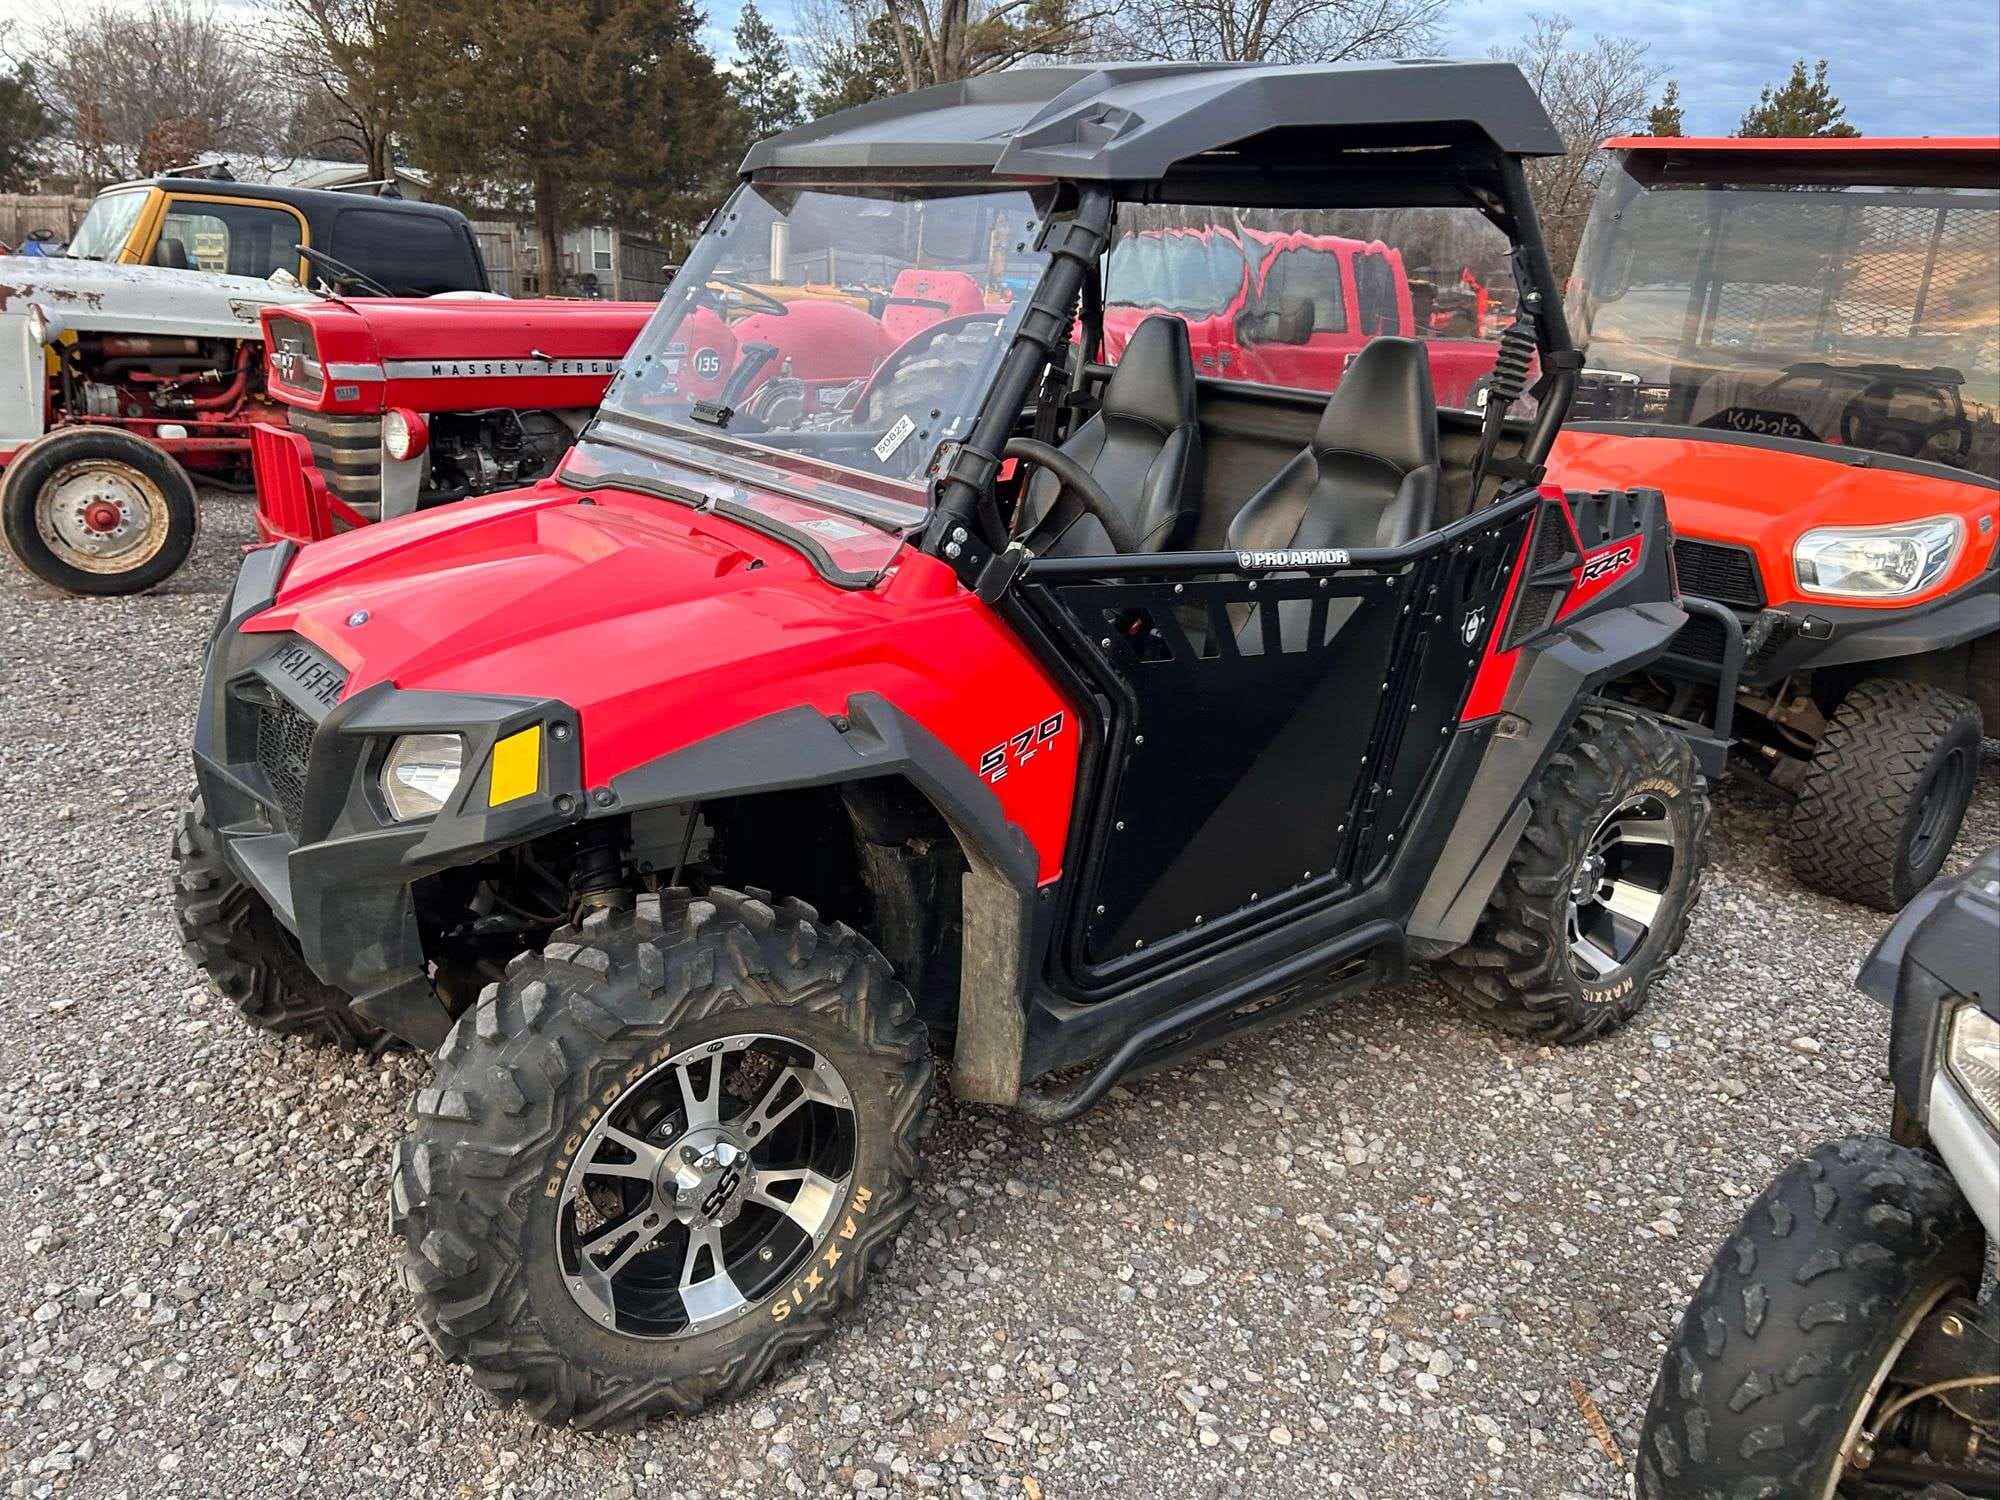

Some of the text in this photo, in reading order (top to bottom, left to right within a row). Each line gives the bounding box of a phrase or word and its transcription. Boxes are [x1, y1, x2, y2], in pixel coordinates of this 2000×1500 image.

[698, 357, 719, 372] 135
[878, 419, 908, 454] 50822
[1726, 411, 1802, 437] Kubota
[1253, 550, 1348, 566] PRO ARMOR
[1577, 546, 1633, 590] RZR
[979, 710, 1064, 777] 570
[1581, 976, 1633, 1003] MAXXIS
[544, 1042, 672, 1198] BIGHORN
[770, 1184, 873, 1322] MAXXIS
